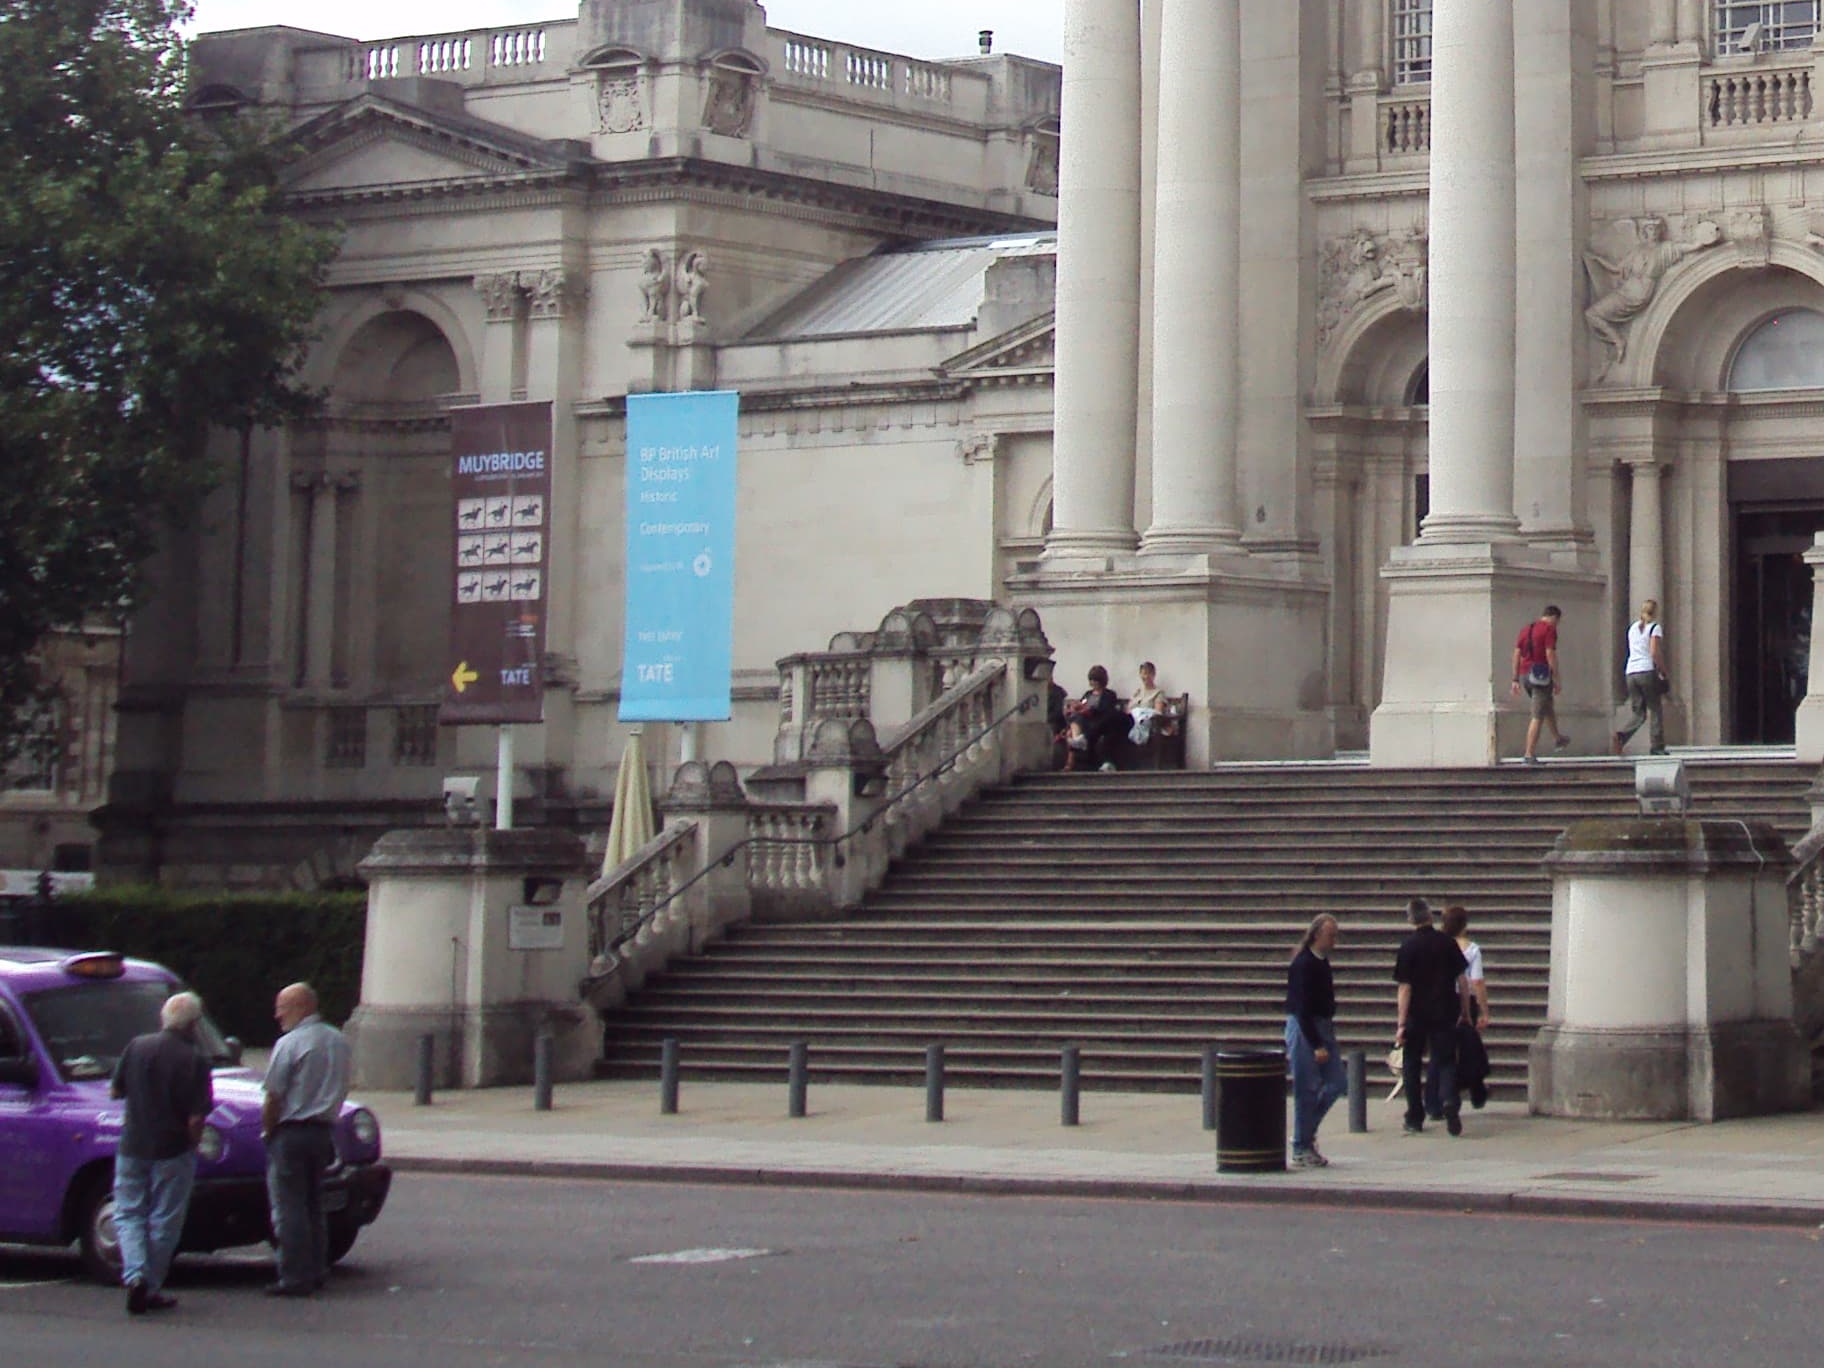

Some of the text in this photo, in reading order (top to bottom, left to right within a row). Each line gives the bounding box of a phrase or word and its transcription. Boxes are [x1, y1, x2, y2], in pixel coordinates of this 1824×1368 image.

[659, 445, 697, 461] British
[459, 451, 544, 474] MUYBRIDGE
[501, 669, 530, 685] TATE
[637, 664, 673, 683] TATE
